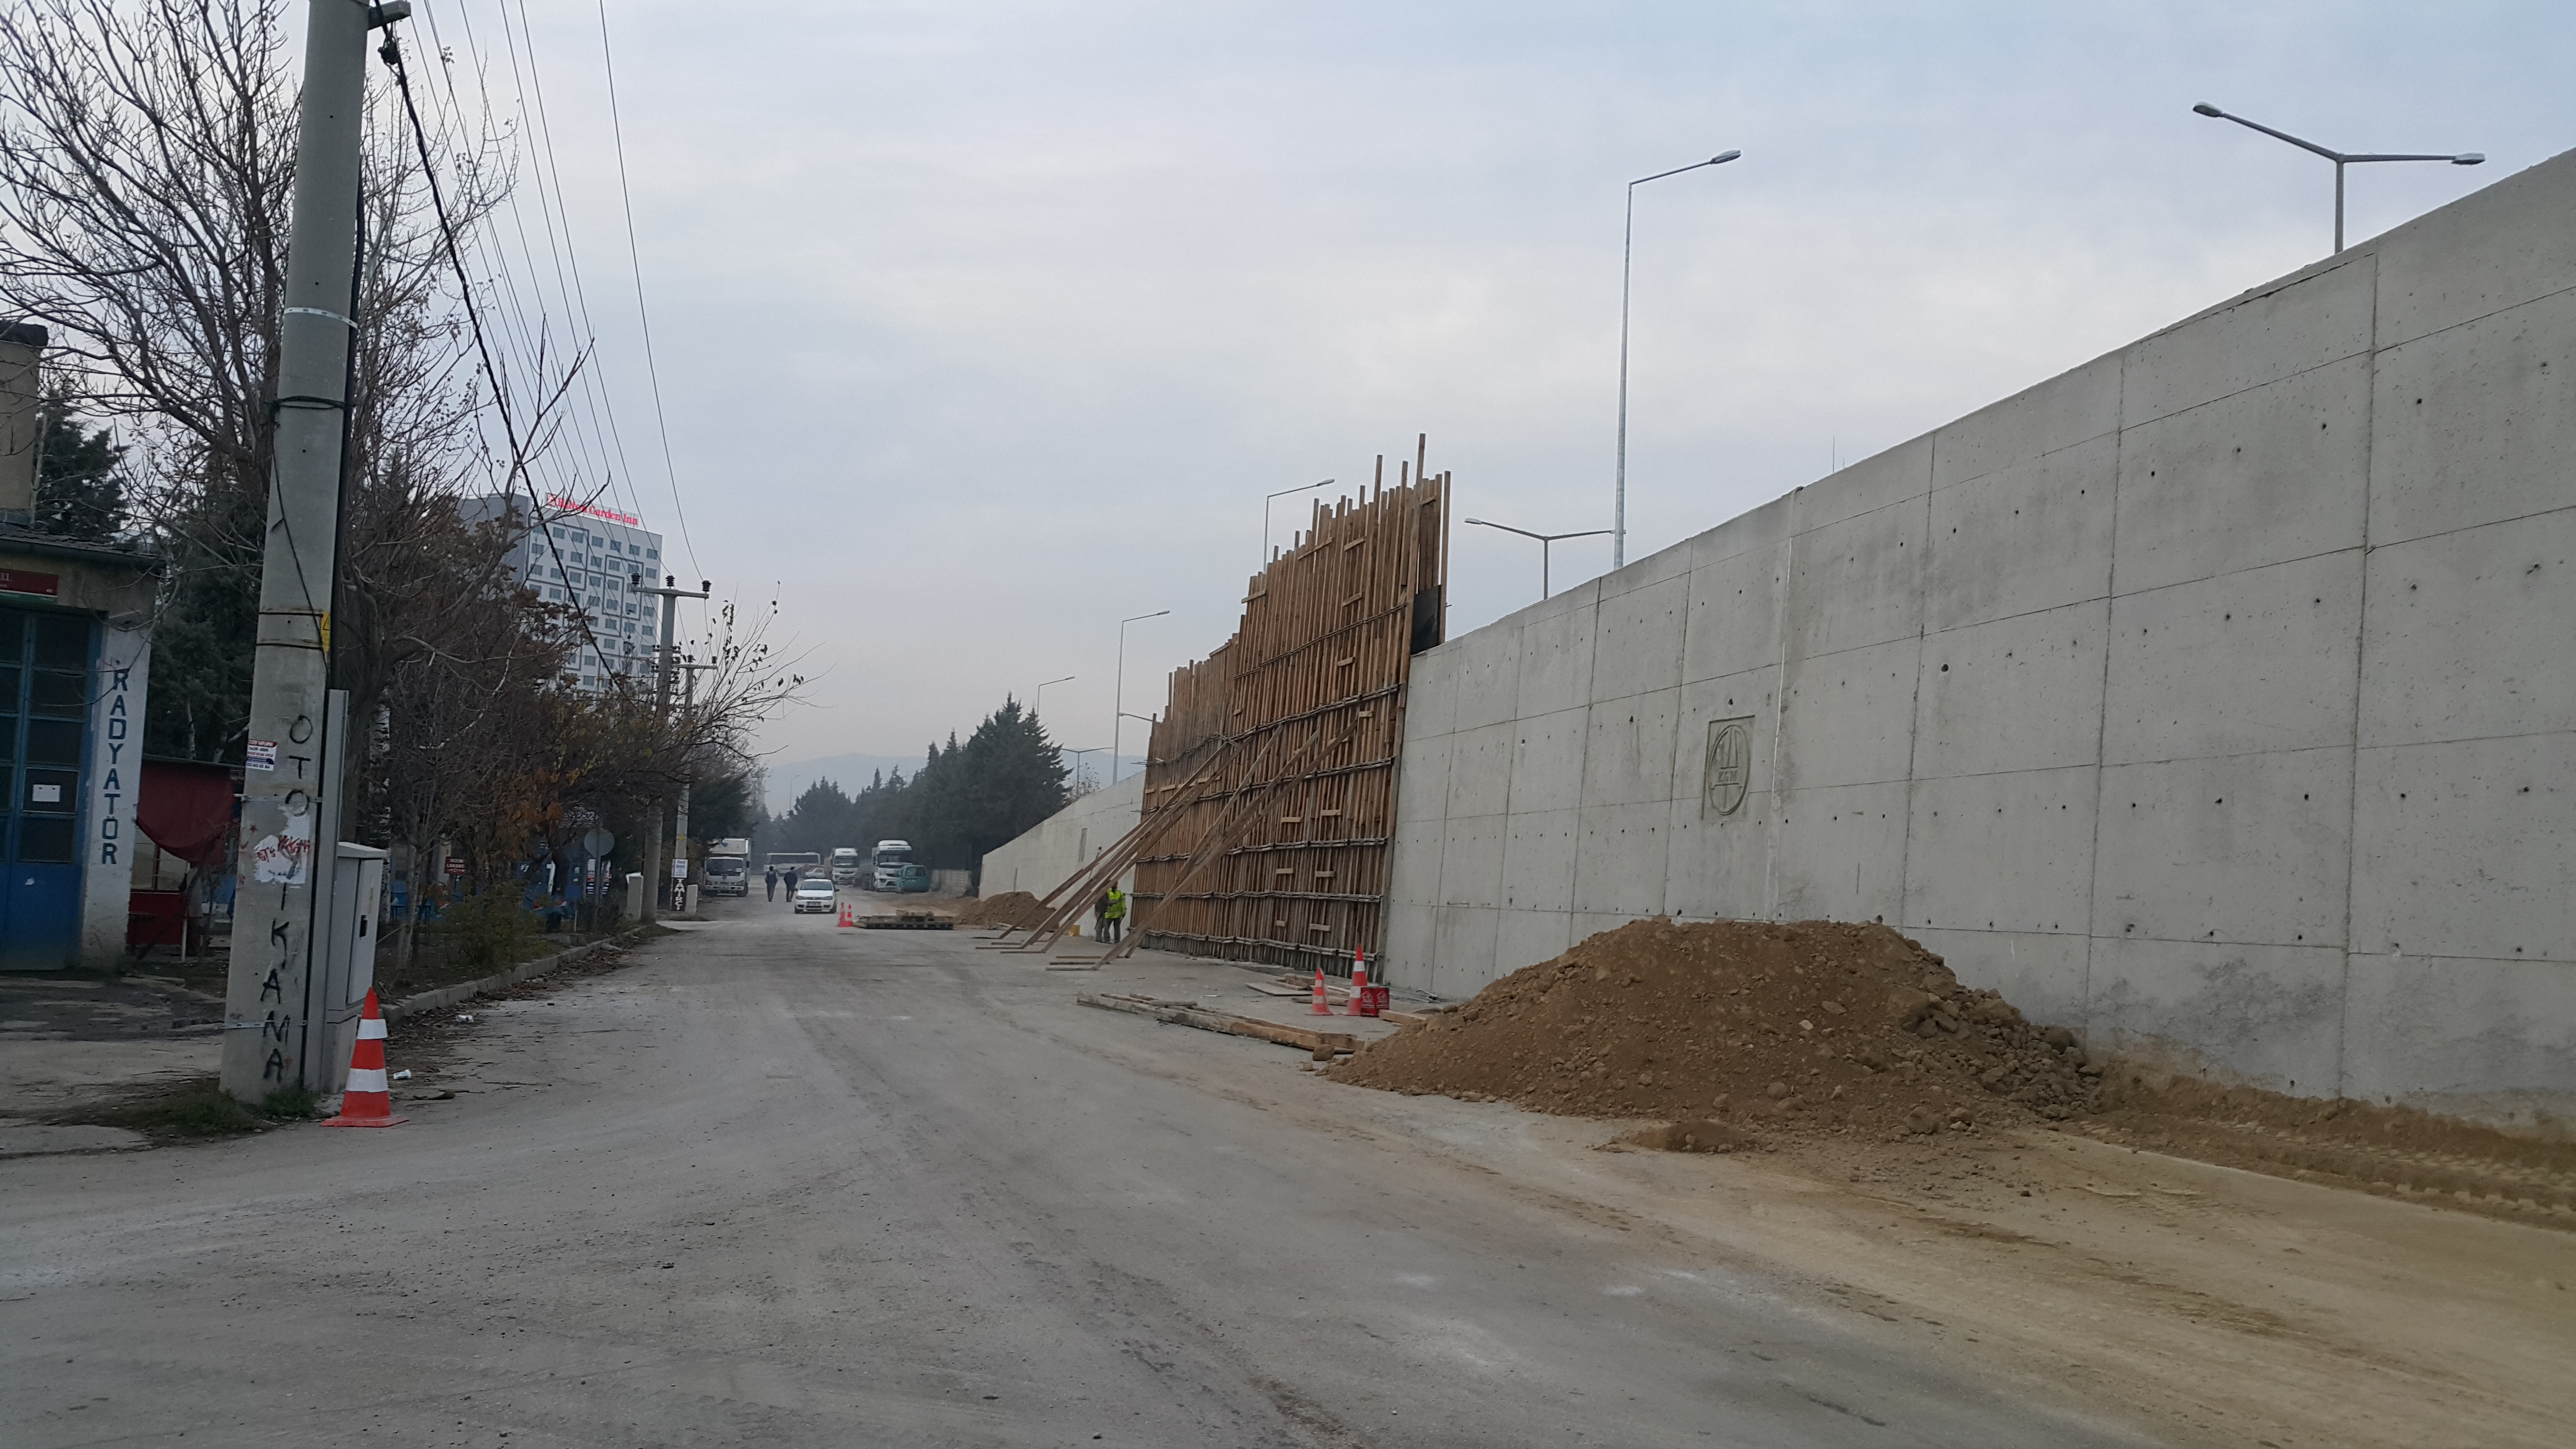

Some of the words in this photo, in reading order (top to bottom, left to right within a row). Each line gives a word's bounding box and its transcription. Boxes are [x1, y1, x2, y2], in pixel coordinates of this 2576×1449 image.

[589, 505, 621, 521] Garden
[623, 513, 638, 525] Inn
[101, 670, 128, 865] RADYATÖR
[285, 714, 314, 817] OTO
